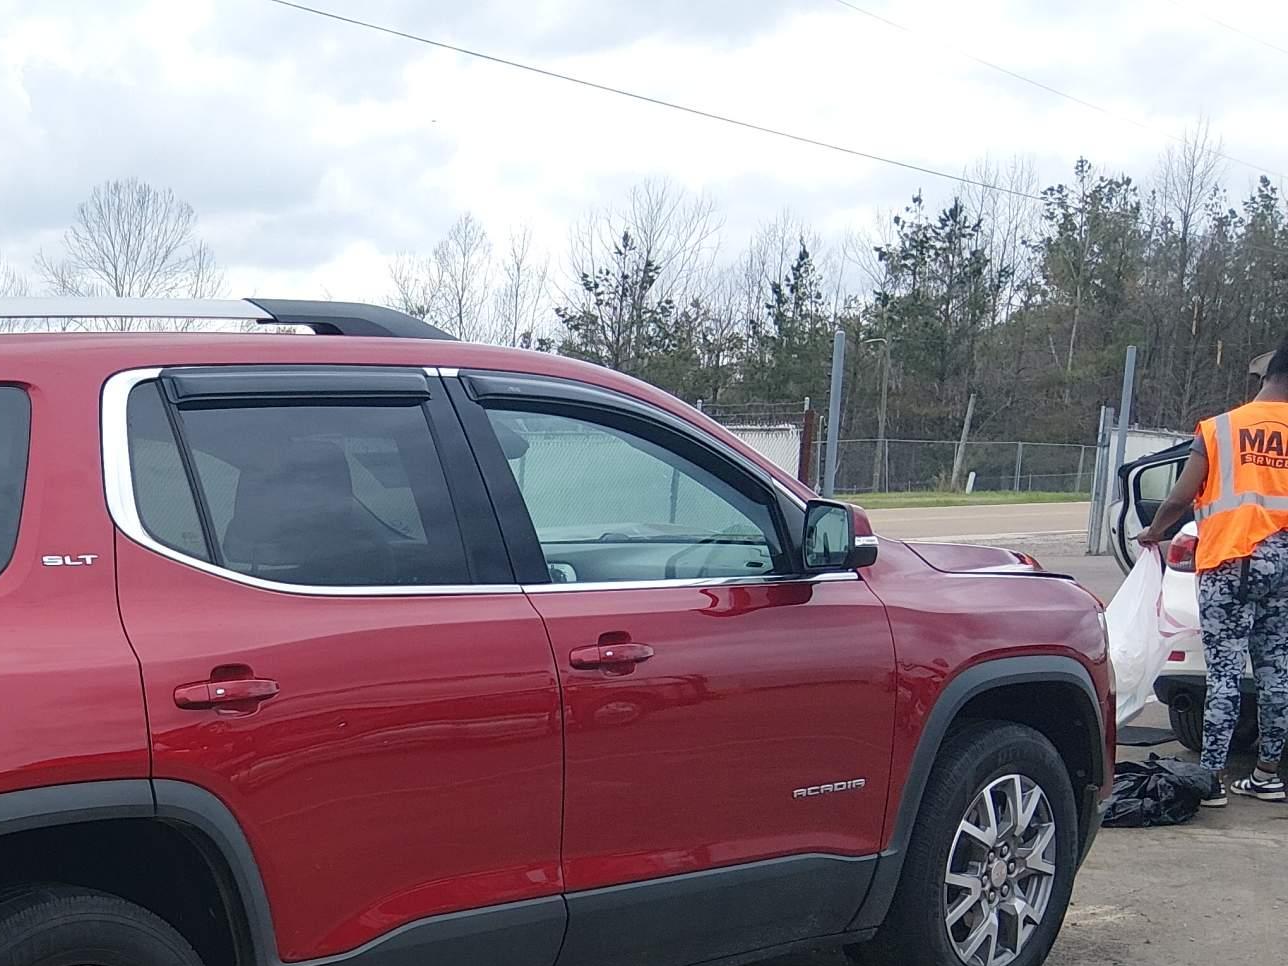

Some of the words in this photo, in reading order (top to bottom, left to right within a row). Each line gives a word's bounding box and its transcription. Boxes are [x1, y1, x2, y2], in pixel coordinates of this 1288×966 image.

[1239, 428, 1288, 457] MA
[42, 554, 99, 566] SLT
[793, 778, 866, 799] ACADIA
